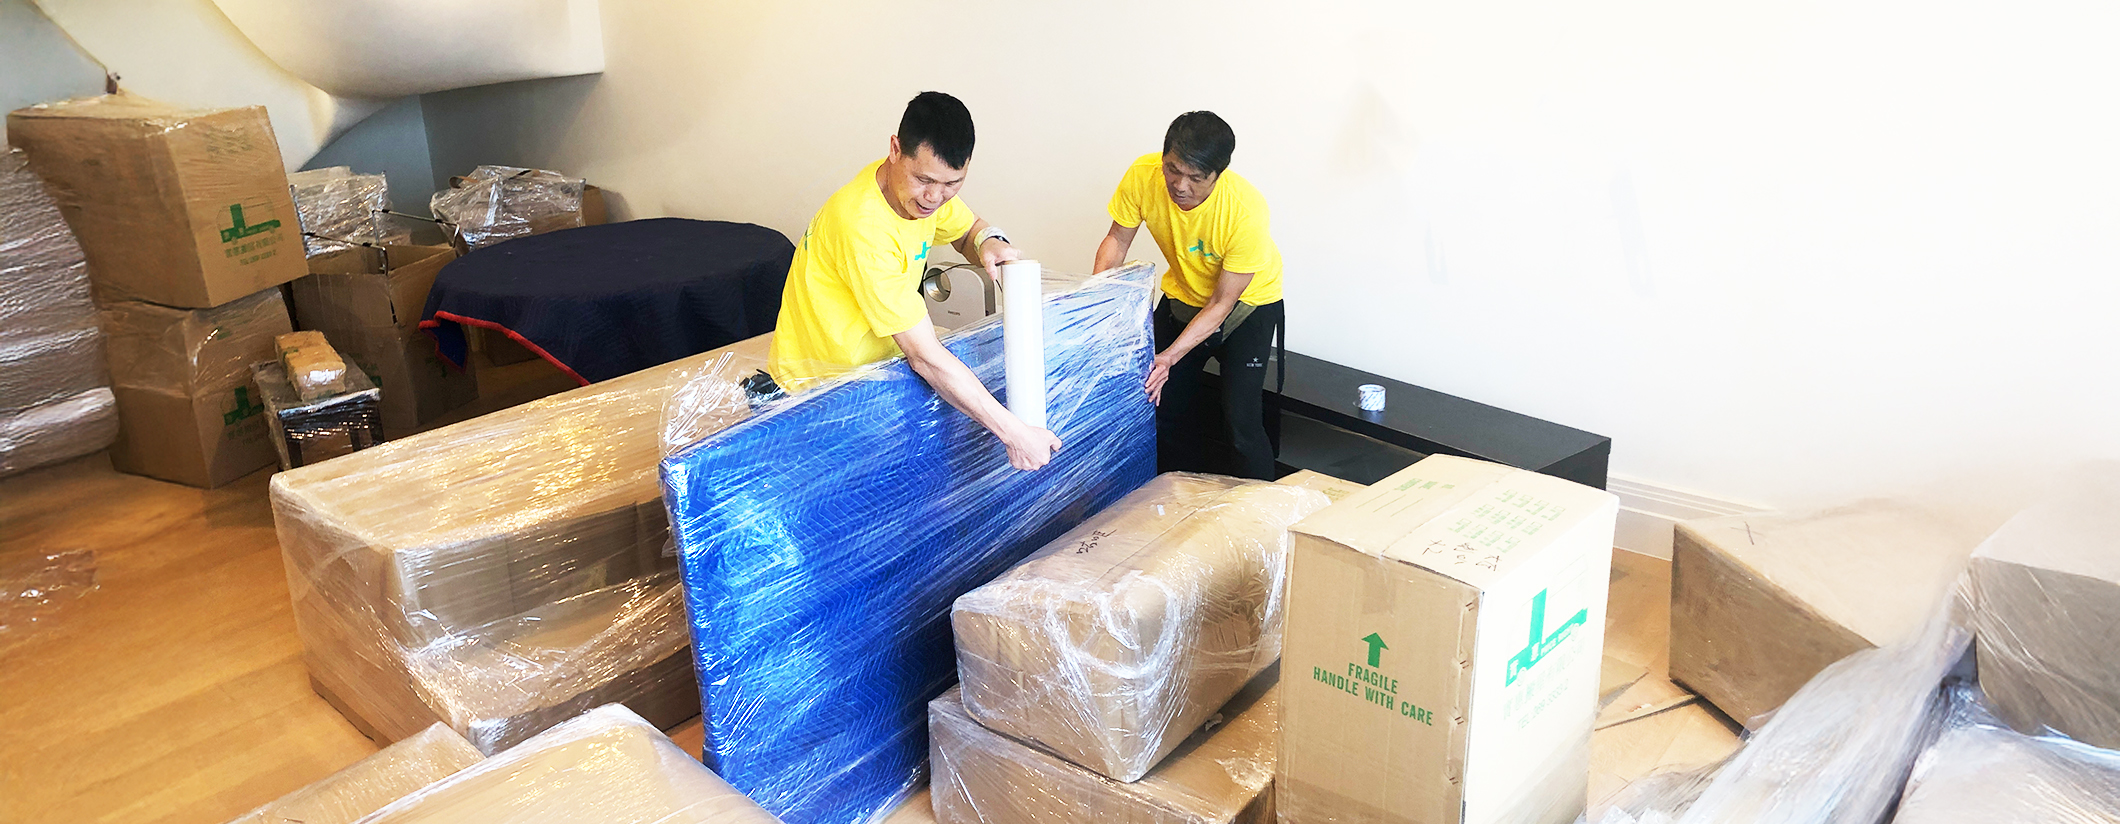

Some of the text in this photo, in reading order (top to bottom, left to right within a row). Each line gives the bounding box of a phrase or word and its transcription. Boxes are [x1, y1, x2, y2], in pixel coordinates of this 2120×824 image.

[1313, 666, 1433, 726] HANDLE WITH CARE
[1348, 662, 1398, 694] FRAGILE
